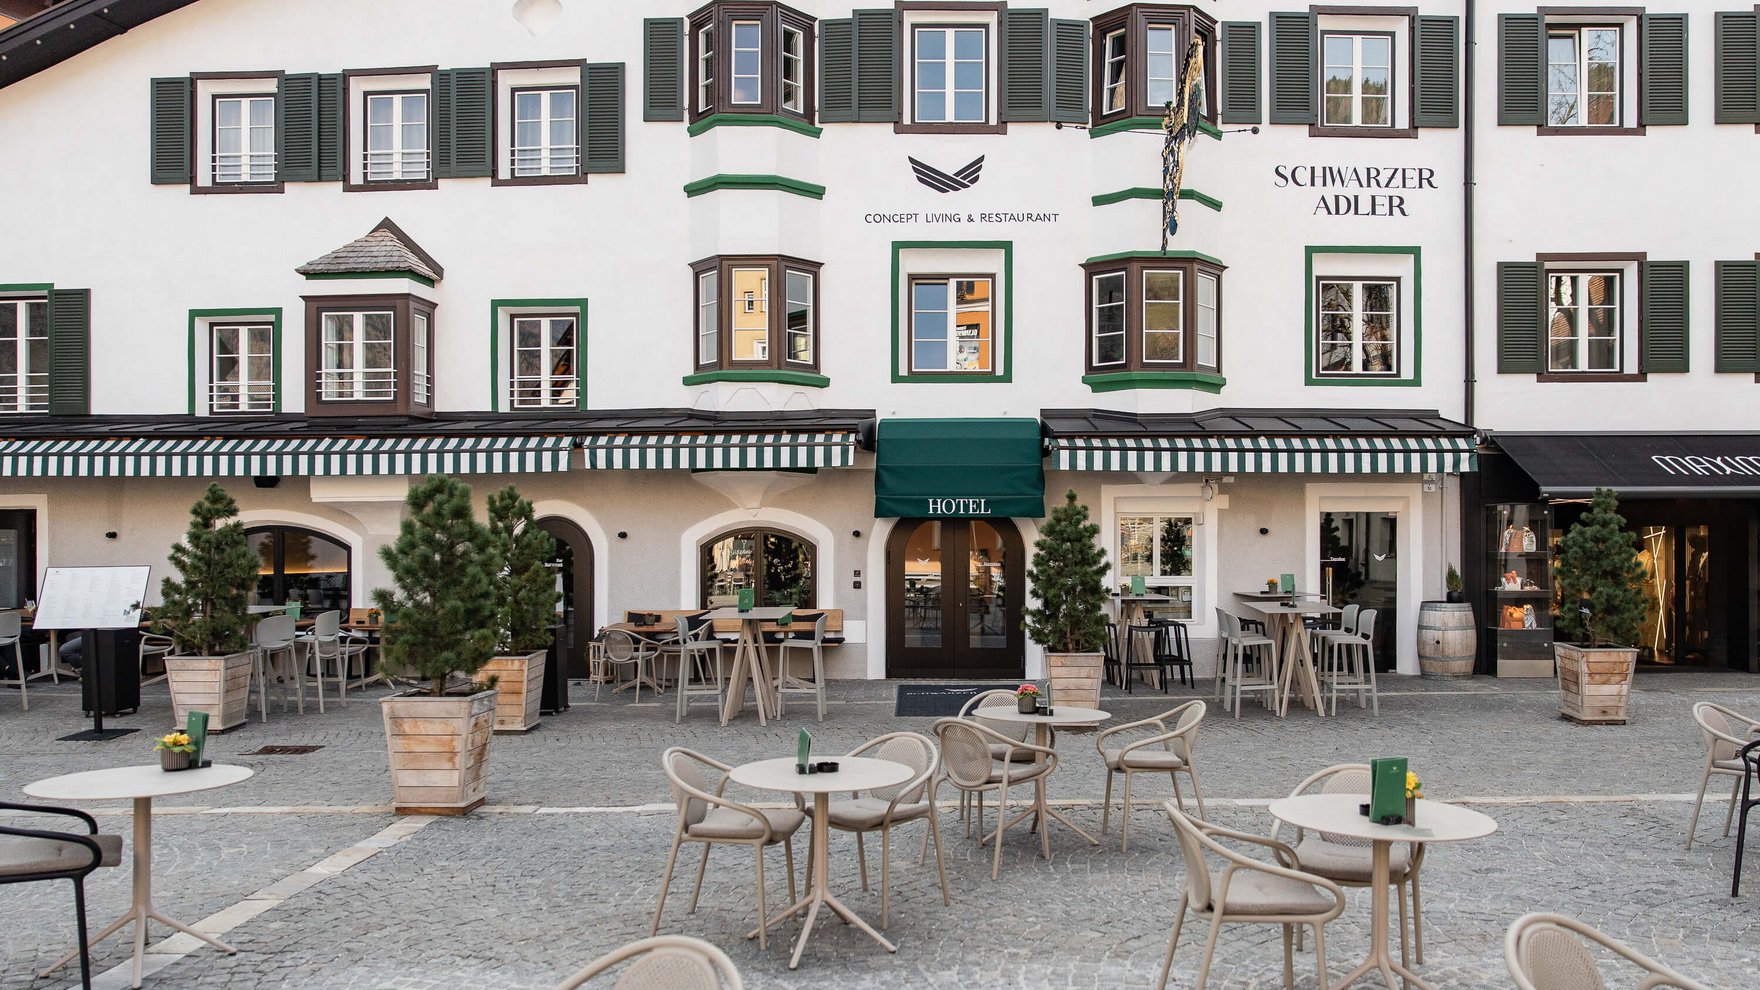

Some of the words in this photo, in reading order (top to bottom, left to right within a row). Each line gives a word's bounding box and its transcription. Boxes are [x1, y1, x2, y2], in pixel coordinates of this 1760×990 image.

[1274, 165, 1438, 189] SCHWARZER
[1313, 194, 1410, 216] ADLER
[865, 213, 919, 223] CONCEPT
[926, 213, 962, 223] LIVING
[967, 213, 976, 223] &
[981, 213, 1060, 223] RESTAURANT
[928, 498, 991, 514] HOTEL
